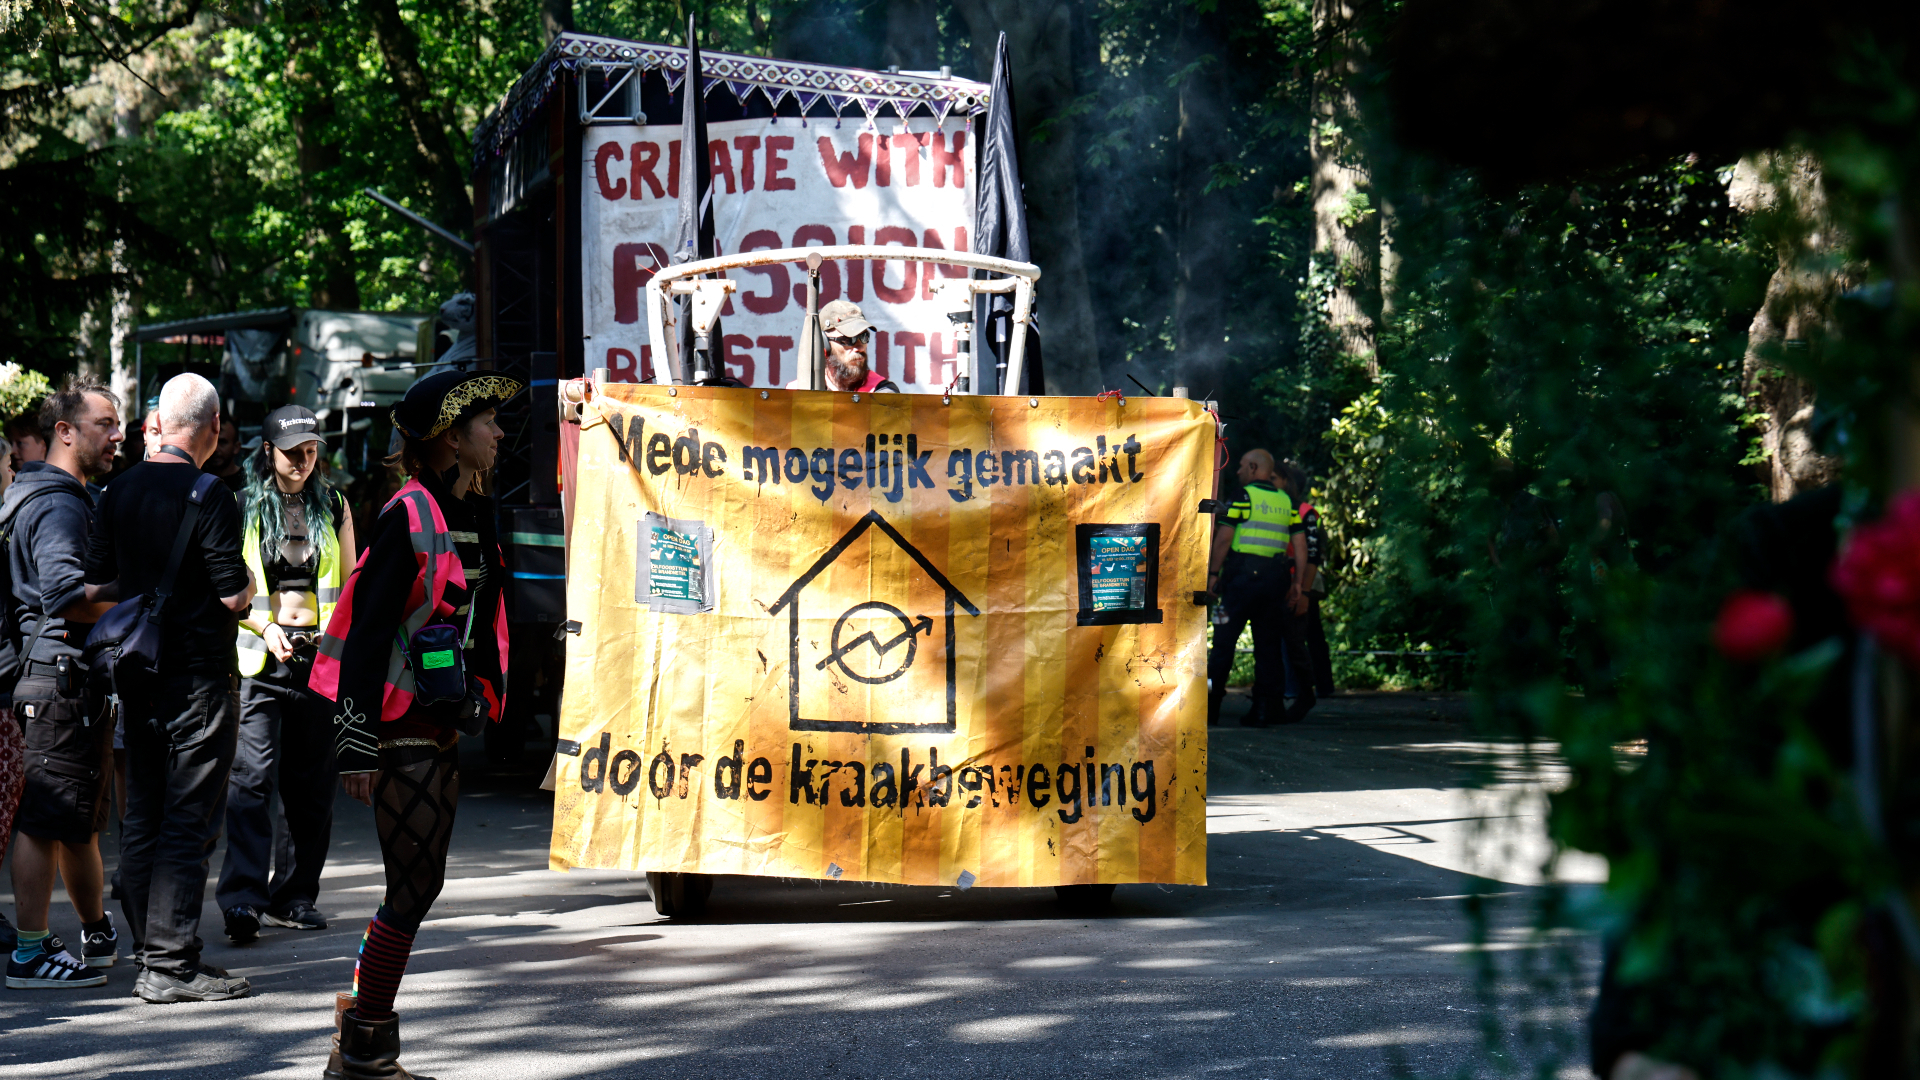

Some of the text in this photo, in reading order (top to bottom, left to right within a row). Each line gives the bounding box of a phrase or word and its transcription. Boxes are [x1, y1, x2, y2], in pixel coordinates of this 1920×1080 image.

[816, 131, 965, 189] WITH
[875, 330, 958, 385] ITH
[609, 413, 1145, 503] Mede mogelijk gemaakt
[581, 732, 1154, 824] door de kraakbeweging
